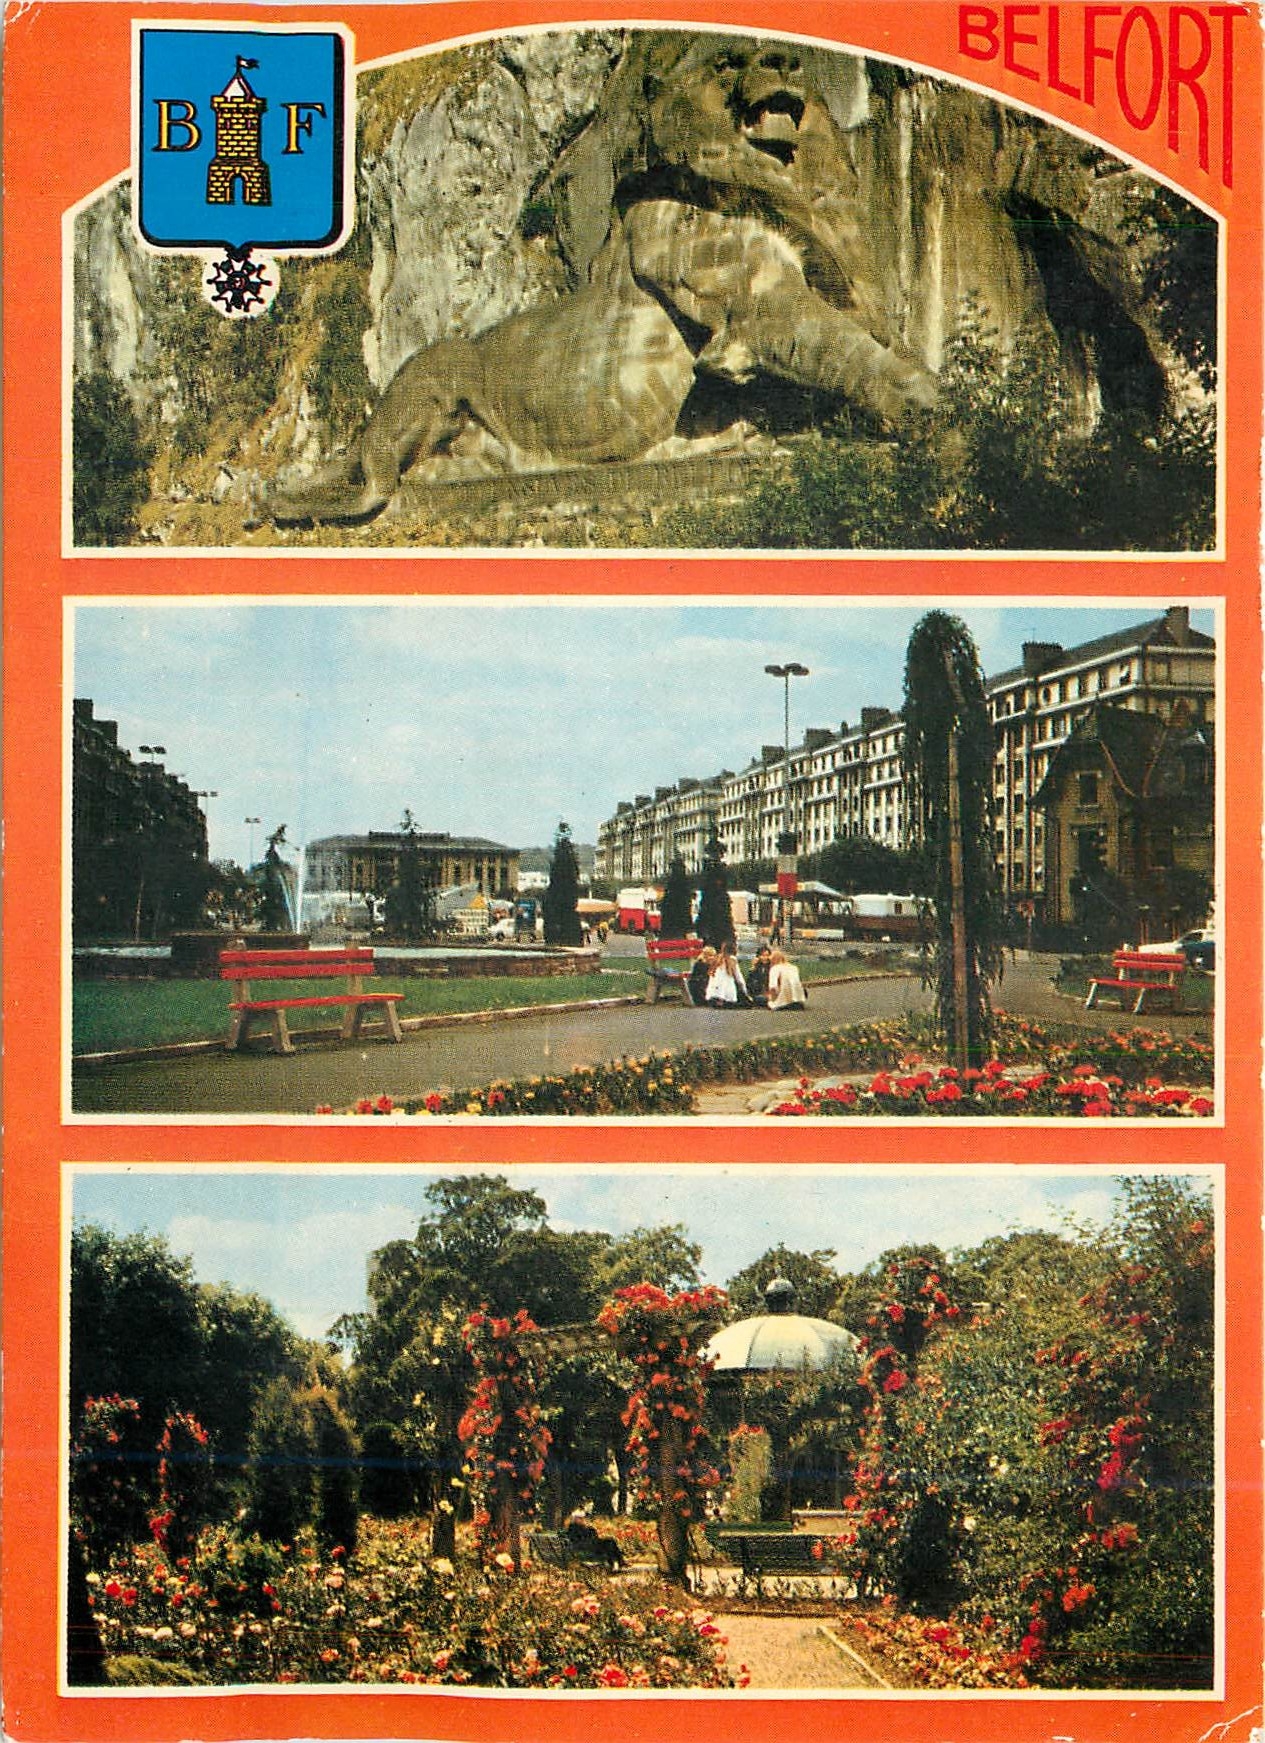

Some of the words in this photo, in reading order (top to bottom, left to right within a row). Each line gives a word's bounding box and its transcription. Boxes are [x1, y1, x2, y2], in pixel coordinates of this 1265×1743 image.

[151, 99, 202, 152] B
[281, 102, 327, 154] F
[959, 4, 1249, 190] BELFORT
